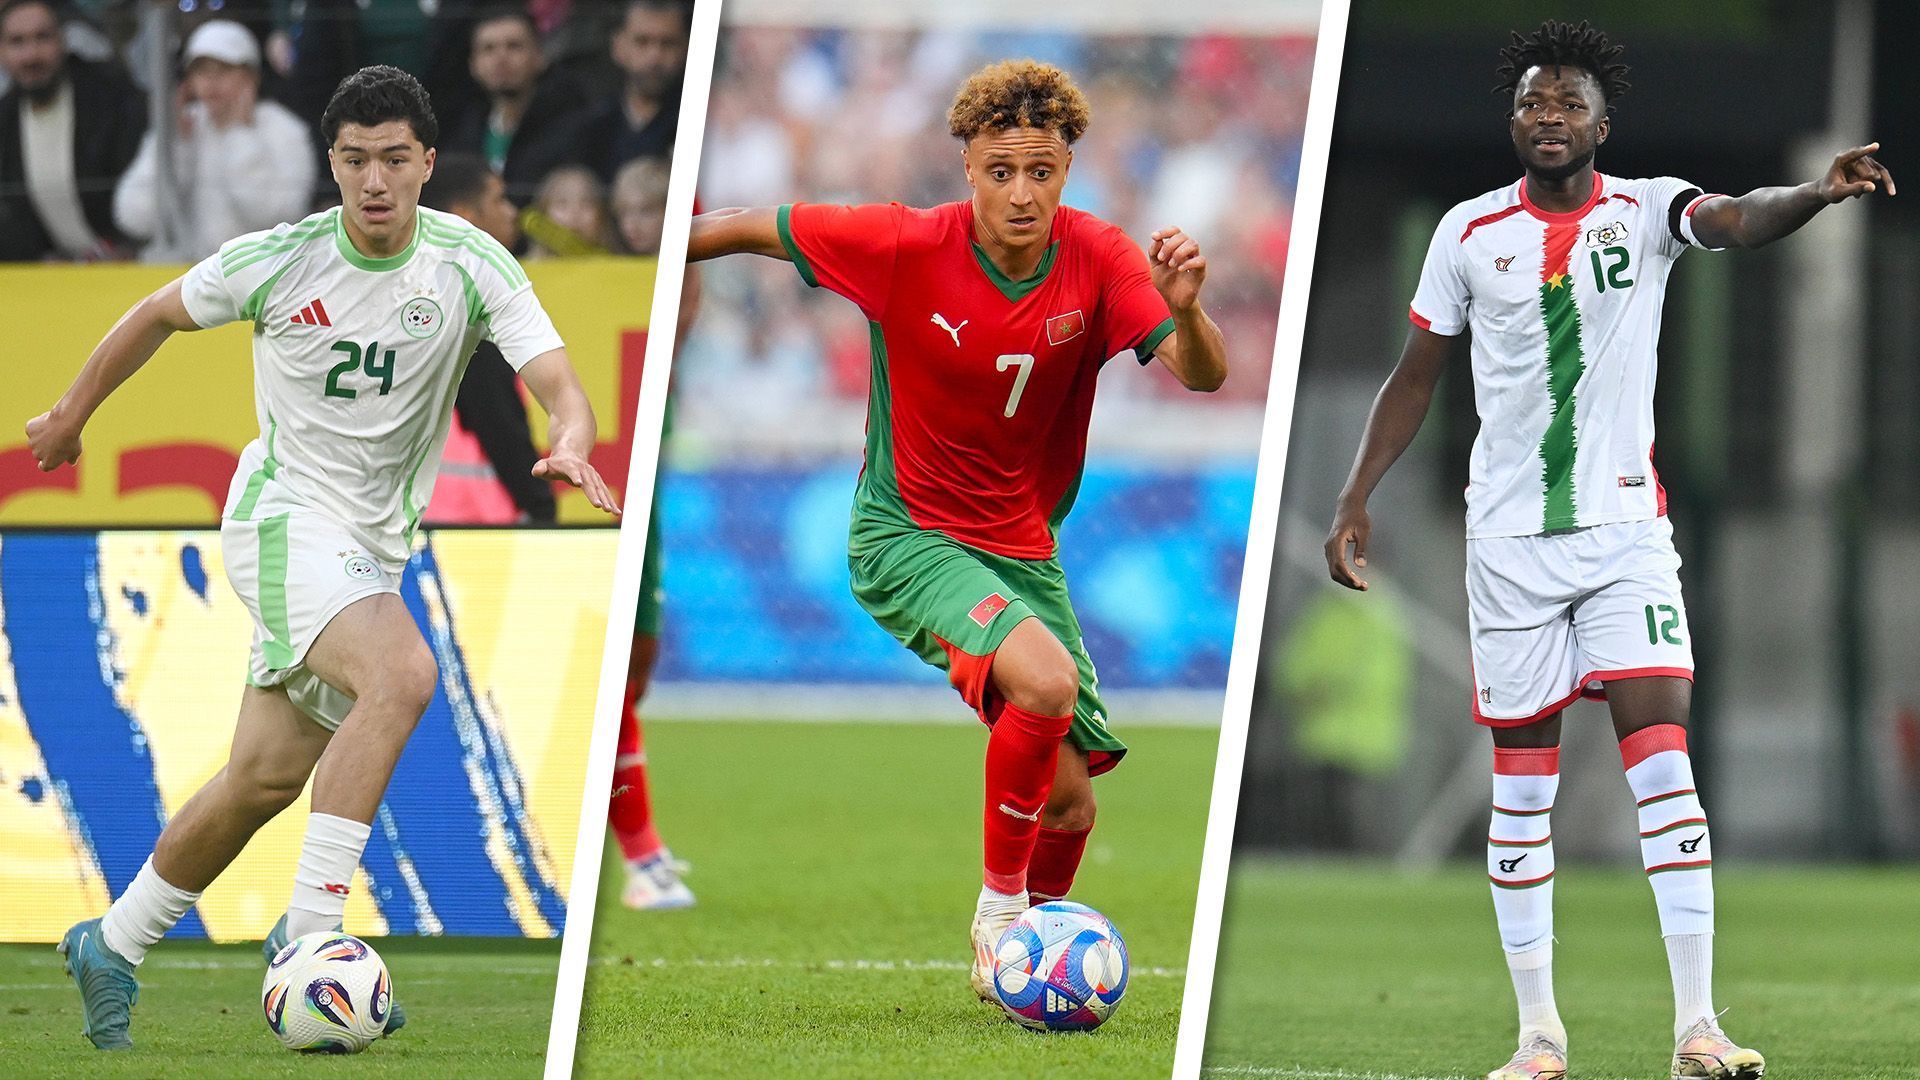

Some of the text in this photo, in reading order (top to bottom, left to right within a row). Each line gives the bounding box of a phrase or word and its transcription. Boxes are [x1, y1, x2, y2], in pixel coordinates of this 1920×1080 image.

[1590, 246, 1634, 294] 12
[325, 340, 396, 399] 24
[996, 354, 1035, 418] 7
[1645, 604, 1682, 645] 12
